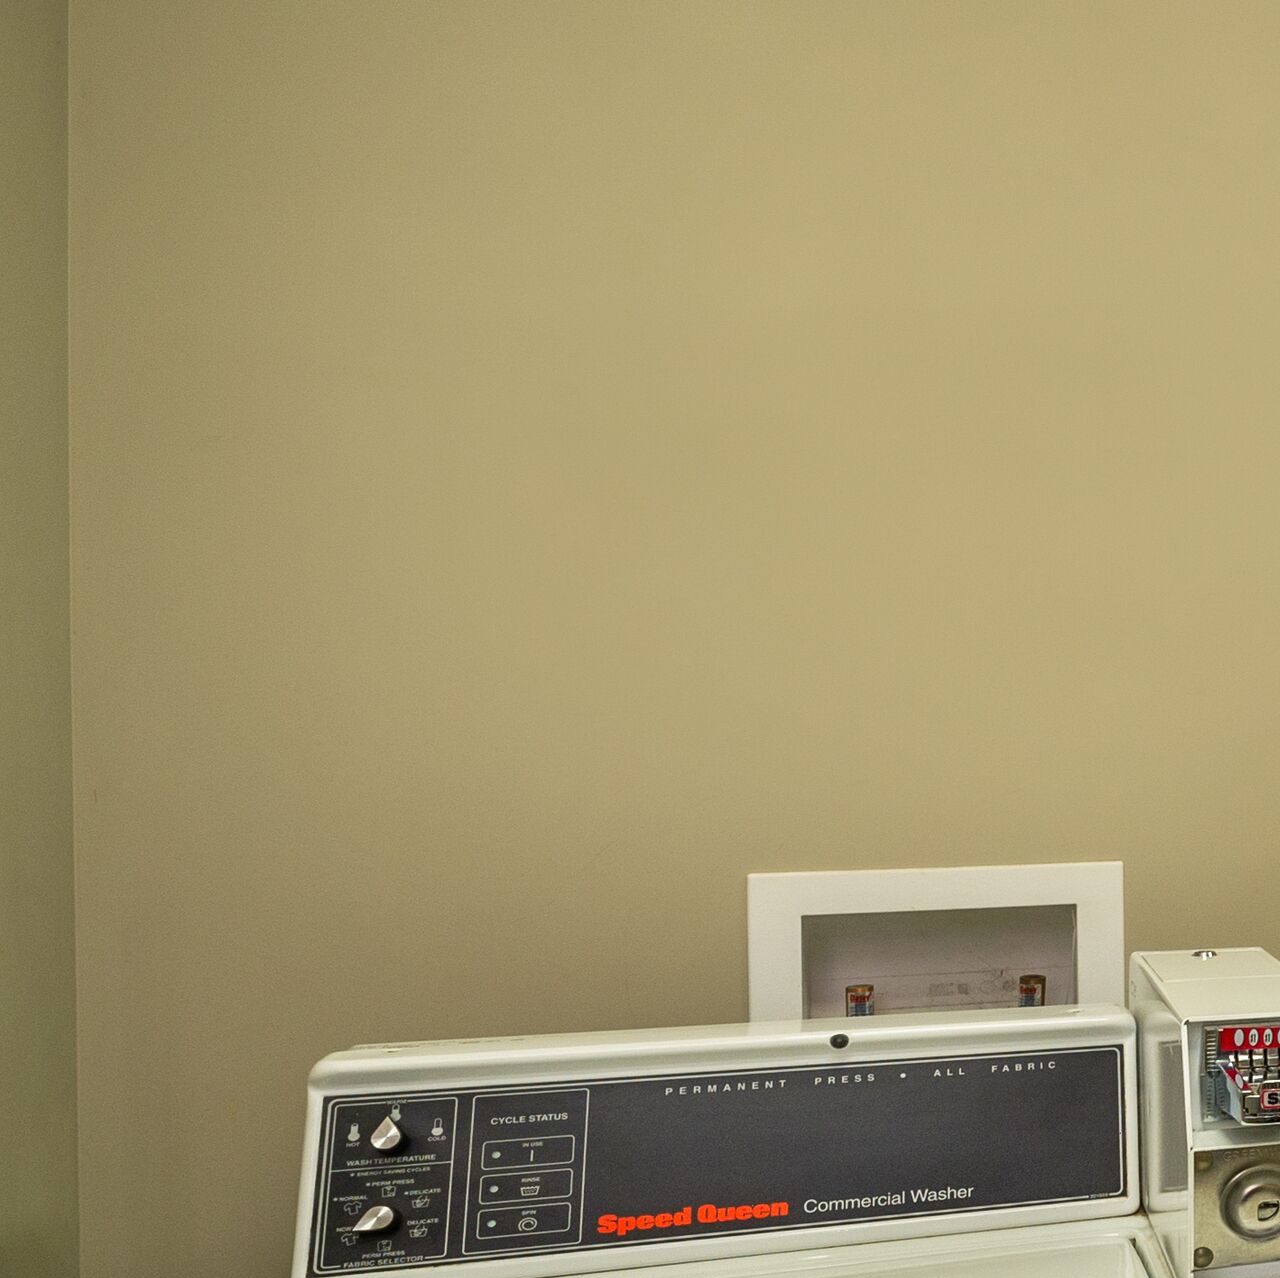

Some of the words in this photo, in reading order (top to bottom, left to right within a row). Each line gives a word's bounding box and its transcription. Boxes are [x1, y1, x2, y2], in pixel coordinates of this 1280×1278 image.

[665, 1079, 788, 1096] PERMANENT
[814, 1073, 877, 1086] PRESS
[933, 1067, 966, 1078] ALL
[991, 1061, 1058, 1073] FABRIC
[490, 1115, 526, 1126] CYCLE
[528, 1112, 569, 1123] STATUS
[346, 1159, 373, 1167] WASH
[374, 1154, 437, 1165] TEMPERATURE
[339, 1194, 368, 1202] NORMAL
[409, 1187, 441, 1196] DELICATE
[597, 1206, 692, 1236] Speed
[696, 1201, 790, 1224] Queen
[803, 1190, 906, 1213] Commercial
[910, 1186, 975, 1203] Washer
[406, 1217, 440, 1226] DELICATE
[343, 1260, 376, 1269] FABRIC
[377, 1255, 424, 1266] SELECTOR
